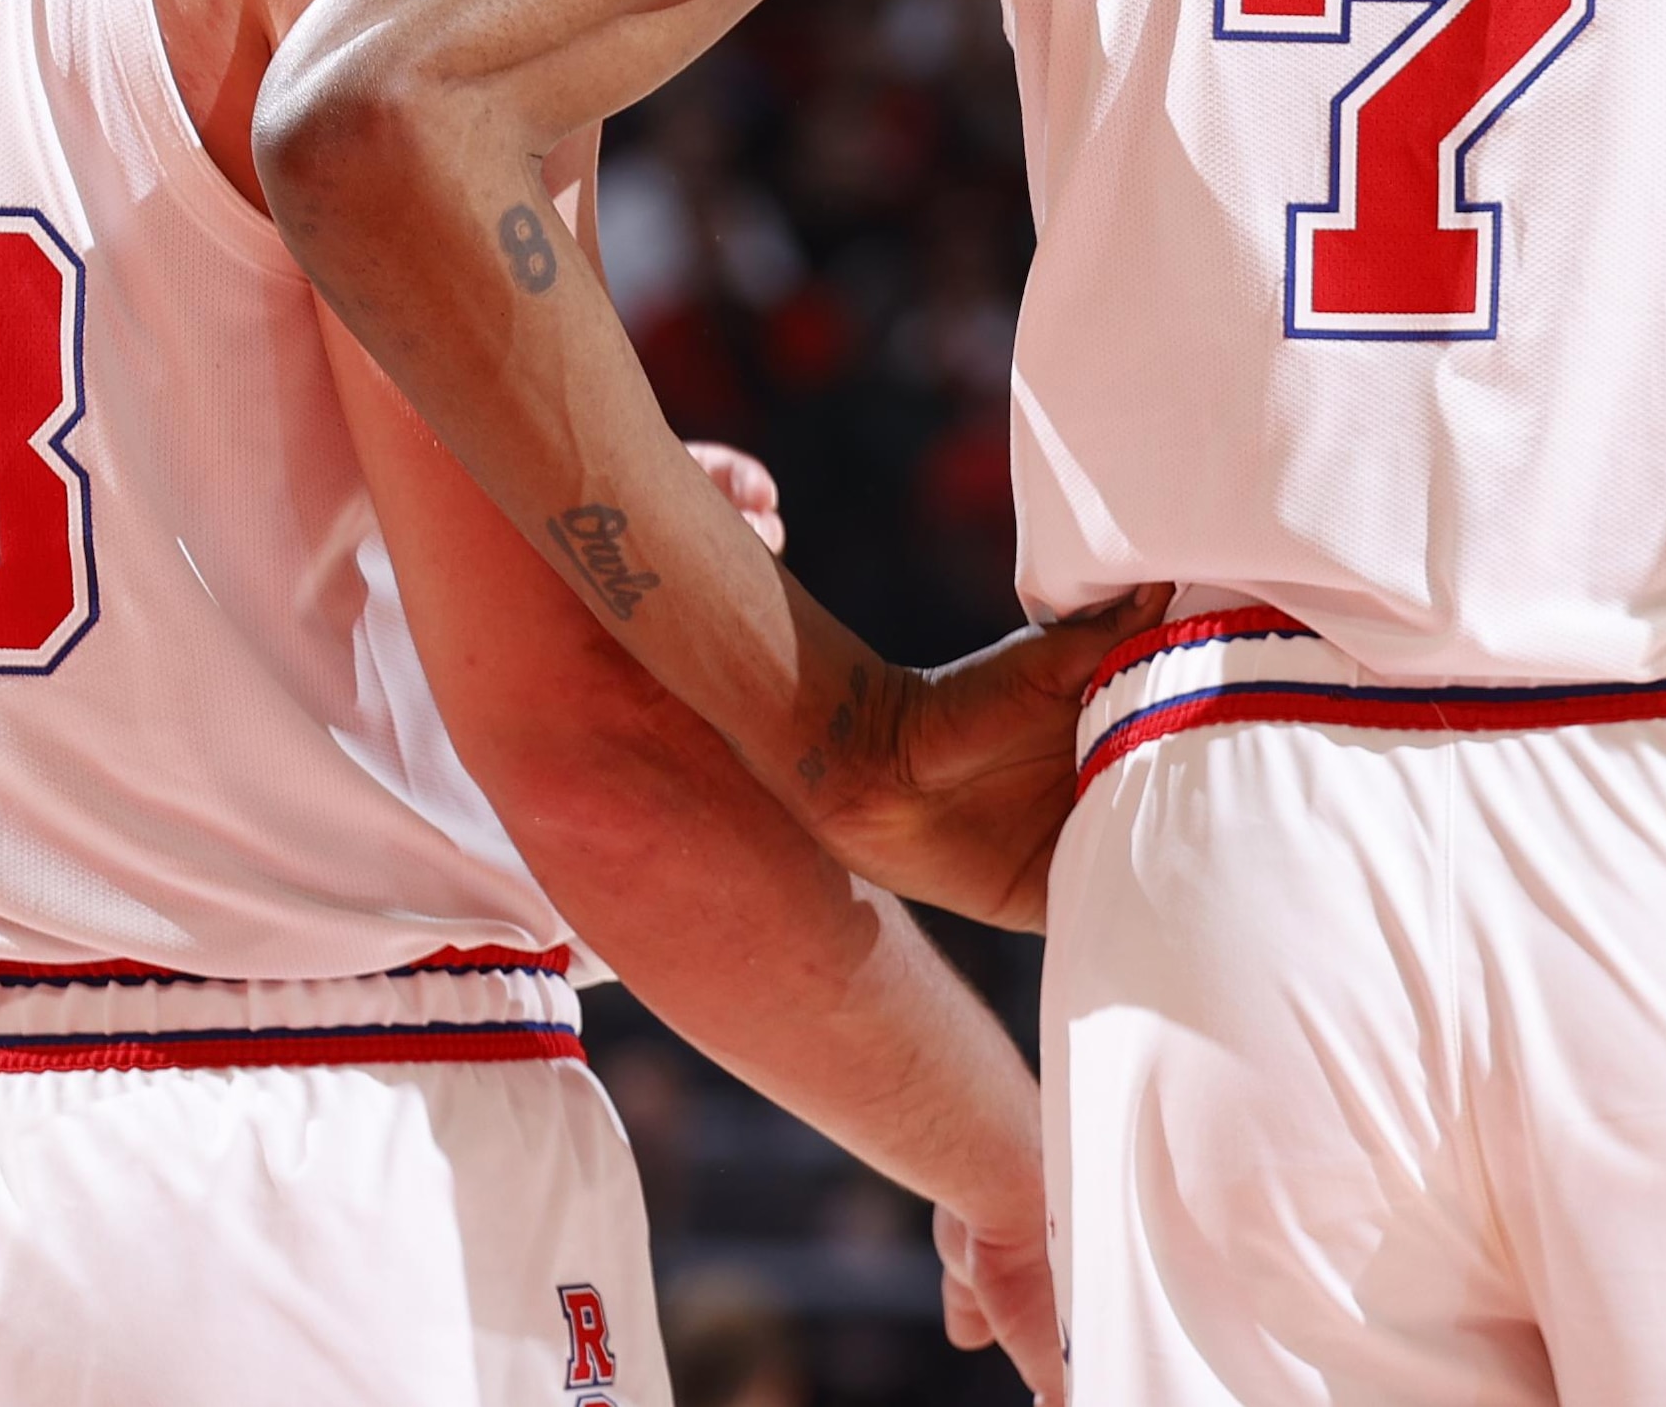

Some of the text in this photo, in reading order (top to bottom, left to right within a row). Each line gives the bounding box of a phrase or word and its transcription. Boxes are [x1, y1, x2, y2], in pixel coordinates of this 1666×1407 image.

[498, 204, 558, 294] 8
[553, 502, 661, 621] Owls
[556, 1283, 619, 1407] R
